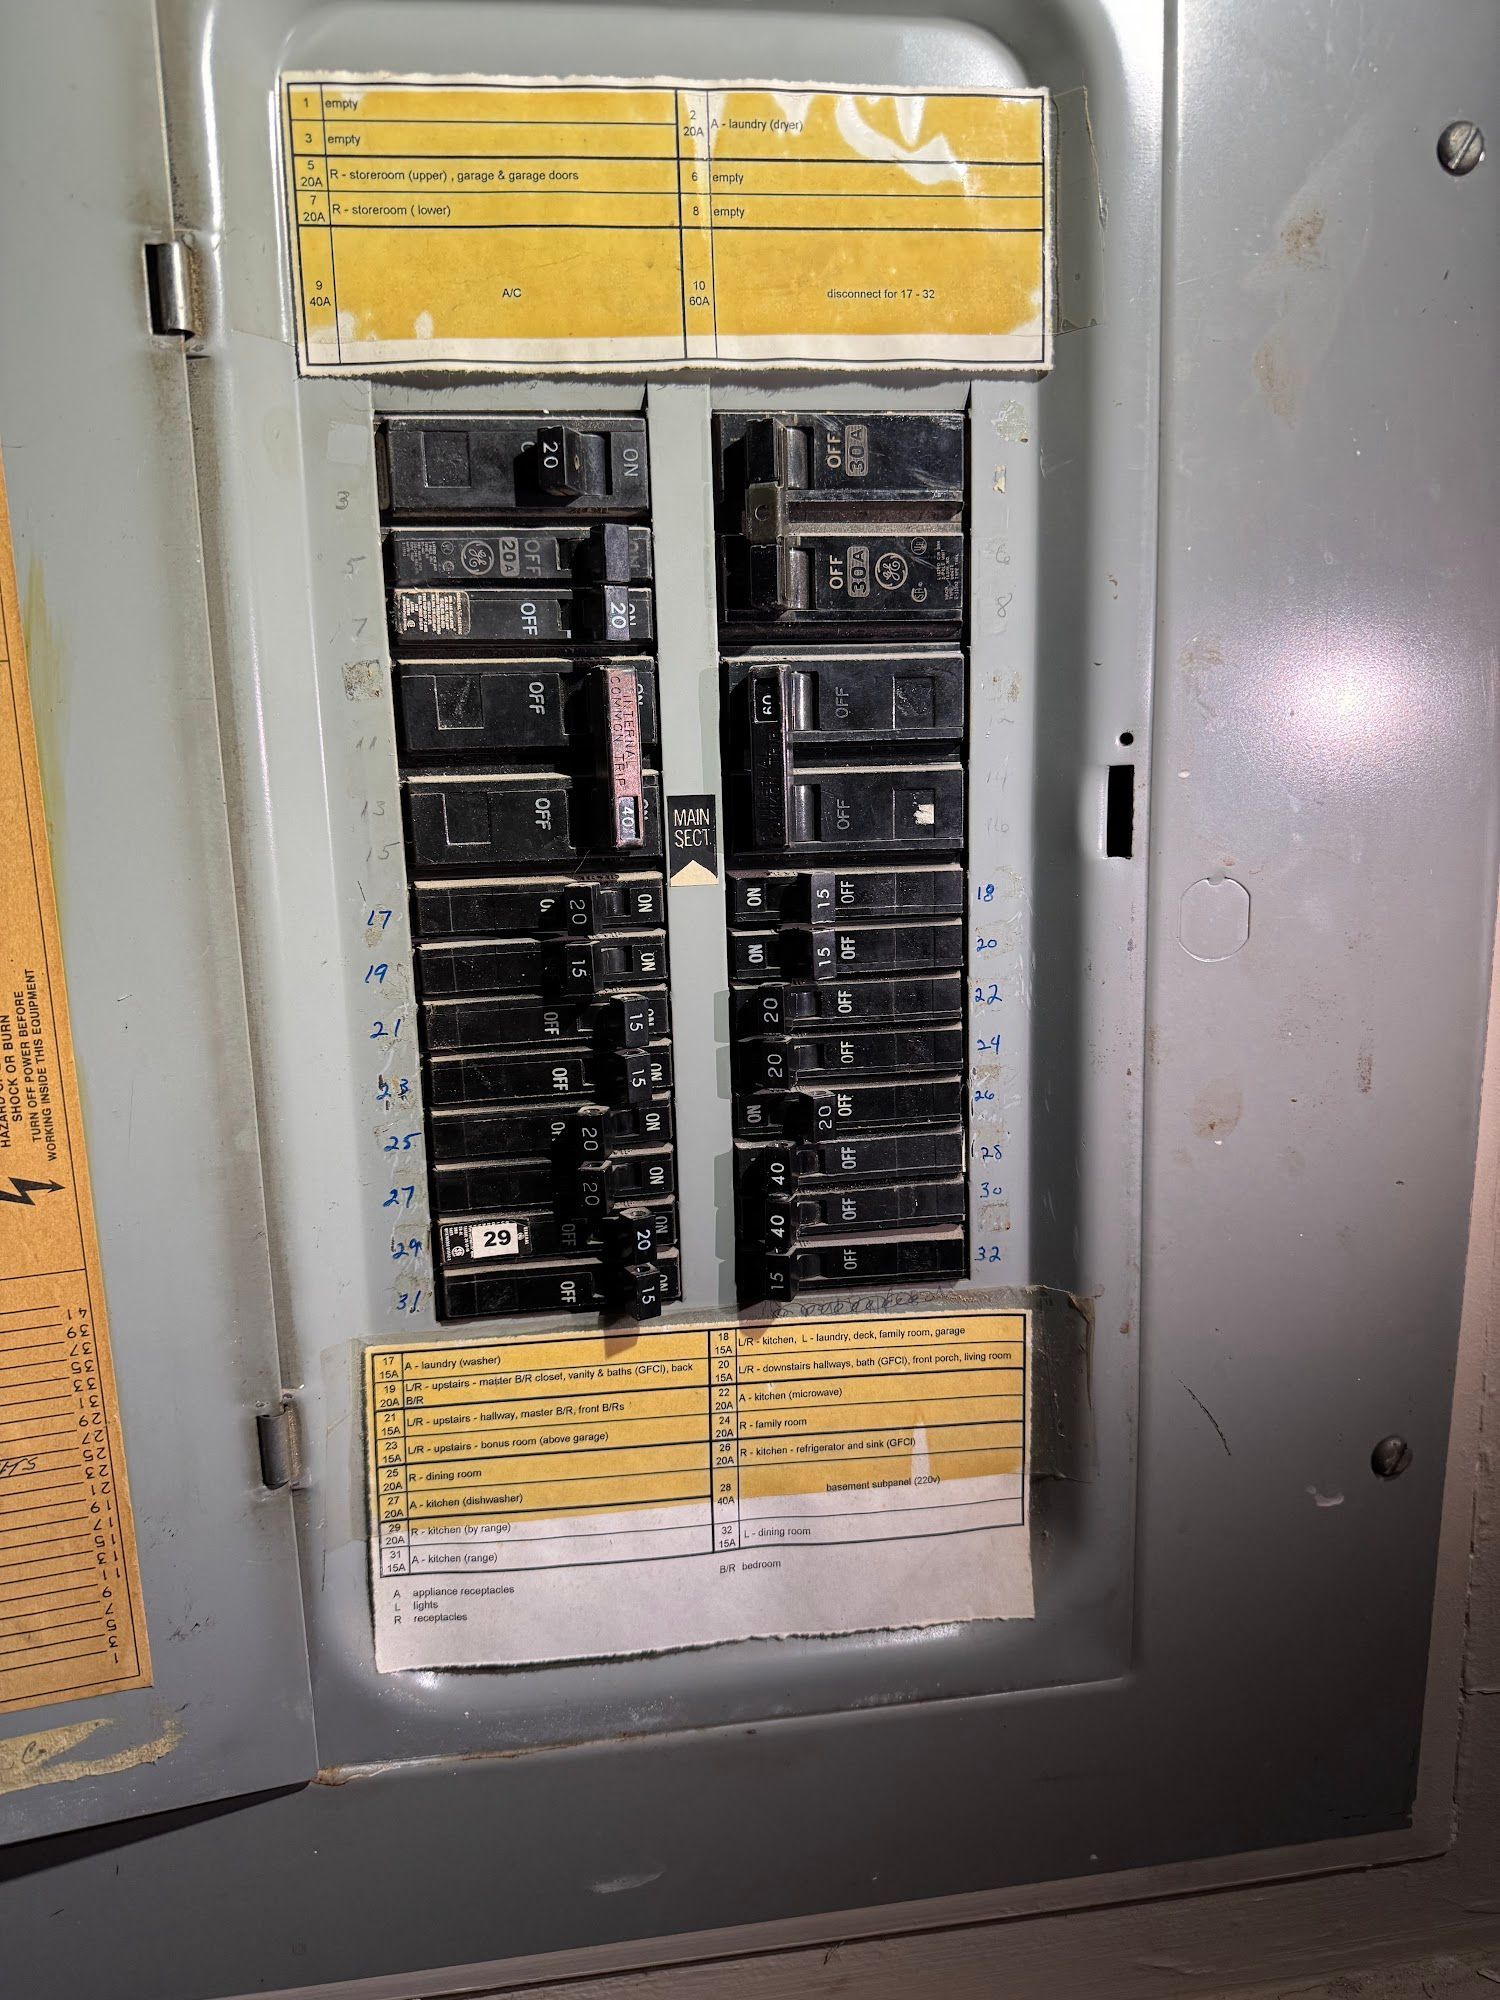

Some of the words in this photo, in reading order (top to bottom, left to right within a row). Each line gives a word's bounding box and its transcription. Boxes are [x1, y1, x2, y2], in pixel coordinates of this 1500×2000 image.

[304, 99, 308, 107] 1
[325, 100, 358, 111] empty
[690, 110, 696, 120] 2
[684, 127, 704, 137] 20A
[711, 119, 719, 129] A
[729, 119, 767, 132] laundry
[770, 119, 803, 132] (dryer)
[307, 160, 314, 170] 5
[301, 176, 323, 187] 20A
[330, 170, 339, 179] R
[350, 170, 405, 180] storeroom
[408, 170, 447, 182] (upper)
[457, 170, 494, 182] garage
[498, 171, 505, 180] &
[508, 171, 545, 182] garage
[548, 170, 578, 180] doors
[691, 173, 698, 182] 6
[712, 172, 744, 184] empty
[333, 204, 341, 214] R
[352, 205, 407, 215] storeroom
[316, 280, 322, 290] 9
[502, 288, 521, 298] A/C
[693, 280, 705, 290] 10
[827, 289, 881, 299] disconnect
[884, 289, 897, 299] for
[901, 289, 912, 299] 17
[923, 289, 935, 299] 32
[310, 297, 331, 307] 40A
[689, 296, 710, 306] 60A
[542, 442, 559, 468] 20
[827, 434, 841, 468] OFF
[847, 427, 866, 474] 30A
[623, 448, 639, 477] ON
[524, 540, 541, 577] OFF
[829, 555, 843, 590] OFF
[850, 550, 867, 595] 30A
[521, 603, 538, 636] OFF
[610, 603, 626, 628] 20
[529, 681, 545, 715] OFF
[611, 676, 623, 748] COMMON
[622, 691, 637, 769] INTERNAL
[614, 755, 626, 787] TRIP
[621, 807, 634, 828] 40
[674, 809, 710, 826] MAIN
[747, 888, 762, 906] ON
[817, 889, 830, 908] 15
[841, 881, 854, 903] OFF
[976, 884, 995, 902] 18
[569, 900, 587, 924] 20
[638, 894, 652, 913] ON
[367, 911, 392, 929] 17
[976, 938, 997, 952] 20
[365, 964, 388, 983] 19
[25, 969, 41, 1034] EQUIPMENT
[975, 985, 1003, 1003] 22
[14, 991, 28, 1037] BEFORE
[630, 1013, 643, 1032] 15
[0, 1015, 13, 1050] BURN
[370, 1019, 401, 1039] 21
[34, 1039, 45, 1064] THIS
[977, 1035, 1000, 1054] 24
[5, 1055, 16, 1073] OR
[20, 1041, 34, 1083] POWER
[37, 1067, 51, 1104] INSIDE
[7, 1078, 22, 1122] SHOCK
[26, 1087, 37, 1108] OFF
[29, 1112, 41, 1143] TURN
[42, 1108, 57, 1161] WORKING
[384, 1133, 422, 1151] 25
[771, 1162, 785, 1186] 40
[383, 1186, 414, 1208] 27
[483, 1230, 512, 1247] 29
[637, 1230, 651, 1251] 20
[975, 1247, 1000, 1262] 32
[560, 1281, 576, 1303] OFF
[67, 1324, 89, 1339] 39
[718, 1333, 729, 1341] 18
[738, 1337, 754, 1347] L/R
[762, 1335, 797, 1345] kitchen,
[802, 1334, 807, 1342] L
[816, 1332, 851, 1343] laundry,
[853, 1330, 877, 1340] deck,
[879, 1328, 905, 1339] family
[907, 1328, 933, 1337] room,
[935, 1326, 965, 1337] garage
[70, 1342, 91, 1356] 37
[715, 1345, 732, 1354] 15A
[71, 1360, 94, 1374] 35
[383, 1357, 394, 1365] 17
[405, 1362, 412, 1370] A
[421, 1359, 457, 1371] laundry
[459, 1356, 501, 1368] (washer)
[739, 1364, 754, 1374] L/R
[763, 1360, 811, 1372] downstairs
[813, 1359, 854, 1370] hallways,
[856, 1357, 875, 1366] bath
[912, 1355, 933, 1363] front
[935, 1353, 962, 1363] porch,
[964, 1352, 986, 1362] living
[988, 1351, 1012, 1360] room
[380, 1370, 398, 1379] 15A
[406, 1383, 422, 1392] L/R
[432, 1379, 470, 1391] upstairs
[479, 1375, 512, 1386] master
[515, 1374, 532, 1383] B/R
[535, 1371, 567, 1382] closet,
[569, 1369, 595, 1380] vanity
[598, 1368, 604, 1376] &
[607, 1366, 632, 1376] baths
[672, 1363, 693, 1372] back
[739, 1393, 746, 1402] A
[754, 1390, 786, 1400] kitchen
[789, 1387, 842, 1399] (microwave)
[407, 1417, 423, 1426] L/R
[433, 1413, 471, 1426] upstairs
[480, 1409, 518, 1421] hallway,
[521, 1408, 554, 1417] master
[578, 1404, 599, 1413] front
[602, 1402, 625, 1411] B/Rs
[408, 1446, 425, 1454] L/R
[434, 1442, 471, 1453] upstairs
[482, 1439, 509, 1448] bonus
[512, 1437, 536, 1446] room
[540, 1435, 570, 1445] (above
[572, 1432, 608, 1443] garage)
[740, 1448, 747, 1457] R
[756, 1446, 788, 1455] kitchen
[796, 1442, 845, 1453] refrigerator
[848, 1441, 863, 1449] and
[866, 1439, 884, 1448] sink
[887, 1437, 915, 1448] (GFCI)
[409, 1473, 416, 1482] R
[426, 1470, 454, 1481] dining
[457, 1469, 482, 1478] room
[826, 1481, 870, 1492] basement
[872, 1477, 911, 1489] subpanel
[914, 1475, 940, 1487] (220v)
[410, 1501, 417, 1509] A
[424, 1497, 460, 1507] kitchen
[463, 1494, 523, 1506] (dishwasher)
[719, 1563, 736, 1574] B/R
[742, 1559, 781, 1570] bedroom
[393, 1590, 401, 1598] A
[413, 1587, 458, 1597] appliance
[461, 1585, 514, 1596] receptacles
